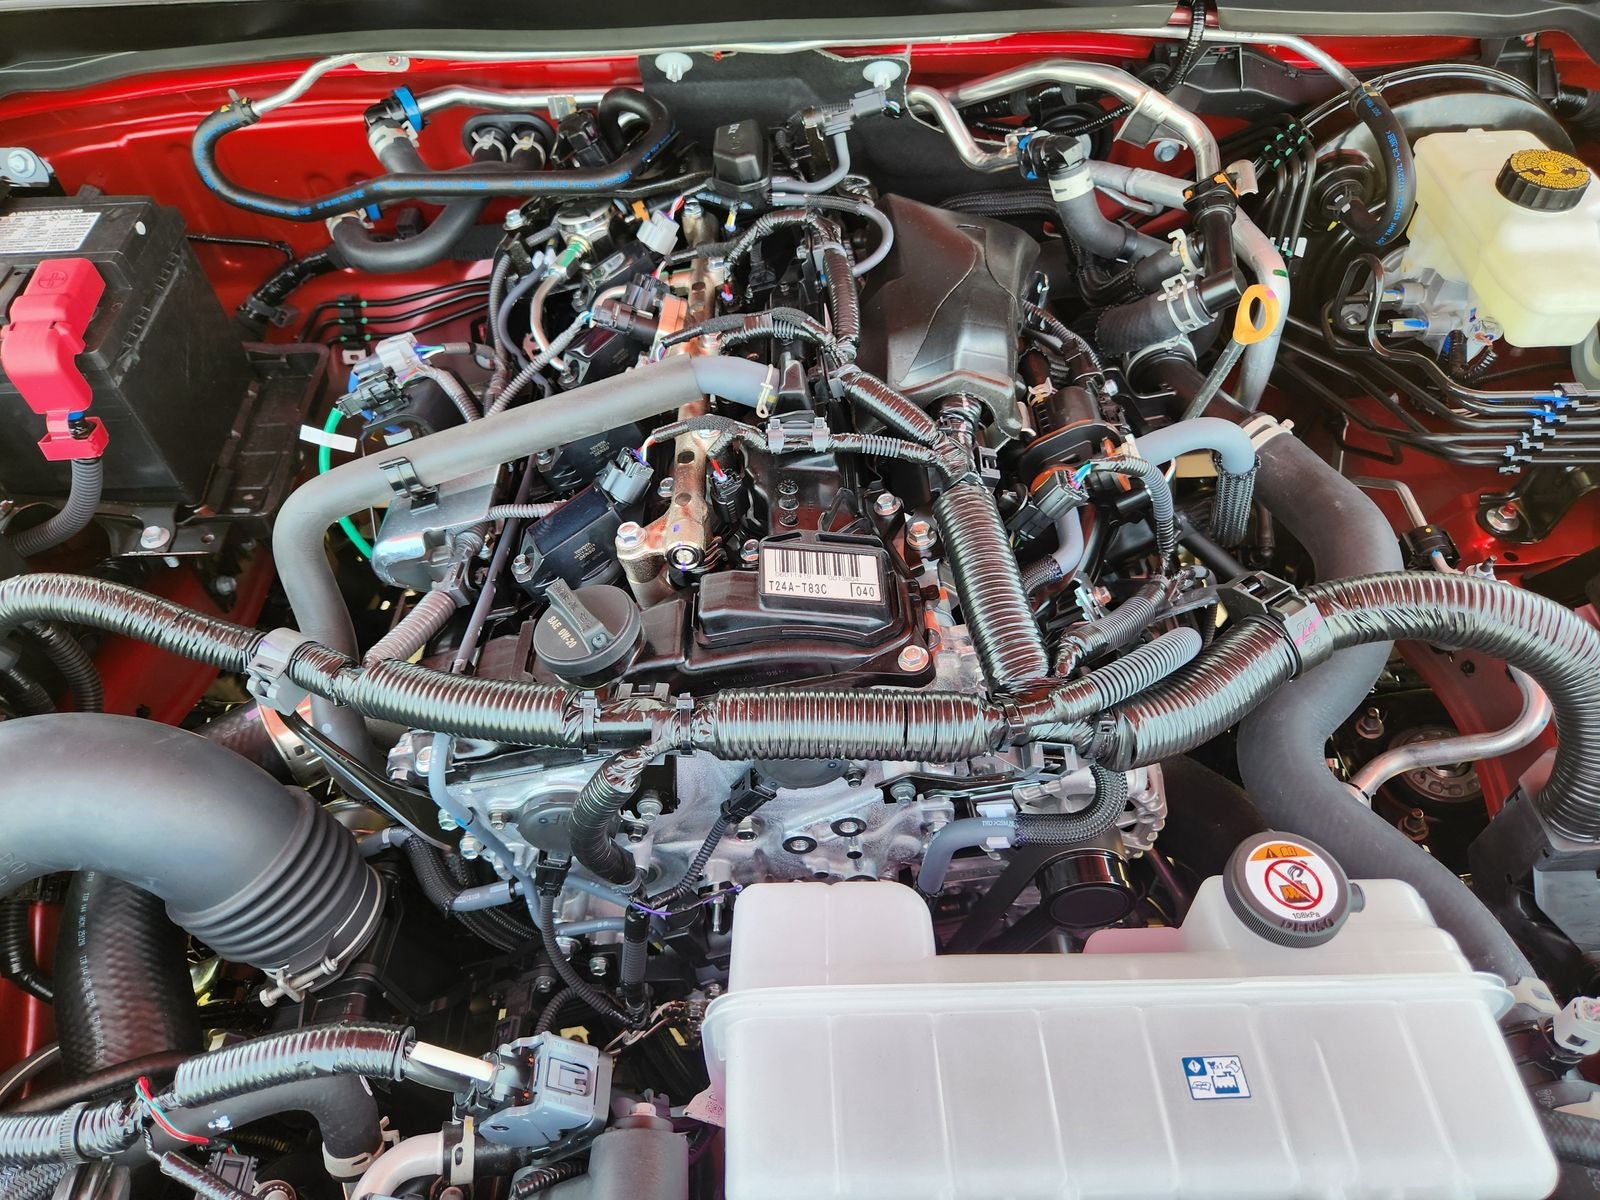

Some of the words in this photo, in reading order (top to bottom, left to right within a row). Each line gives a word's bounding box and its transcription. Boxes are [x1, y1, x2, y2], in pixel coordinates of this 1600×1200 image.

[769, 580, 827, 595] T24A-T83C
[856, 586, 875, 597] 040
[547, 615, 562, 630] SAE
[558, 628, 577, 649] 0W-20
[1292, 911, 1320, 919] 108kPa
[1281, 918, 1335, 933] DENSO
